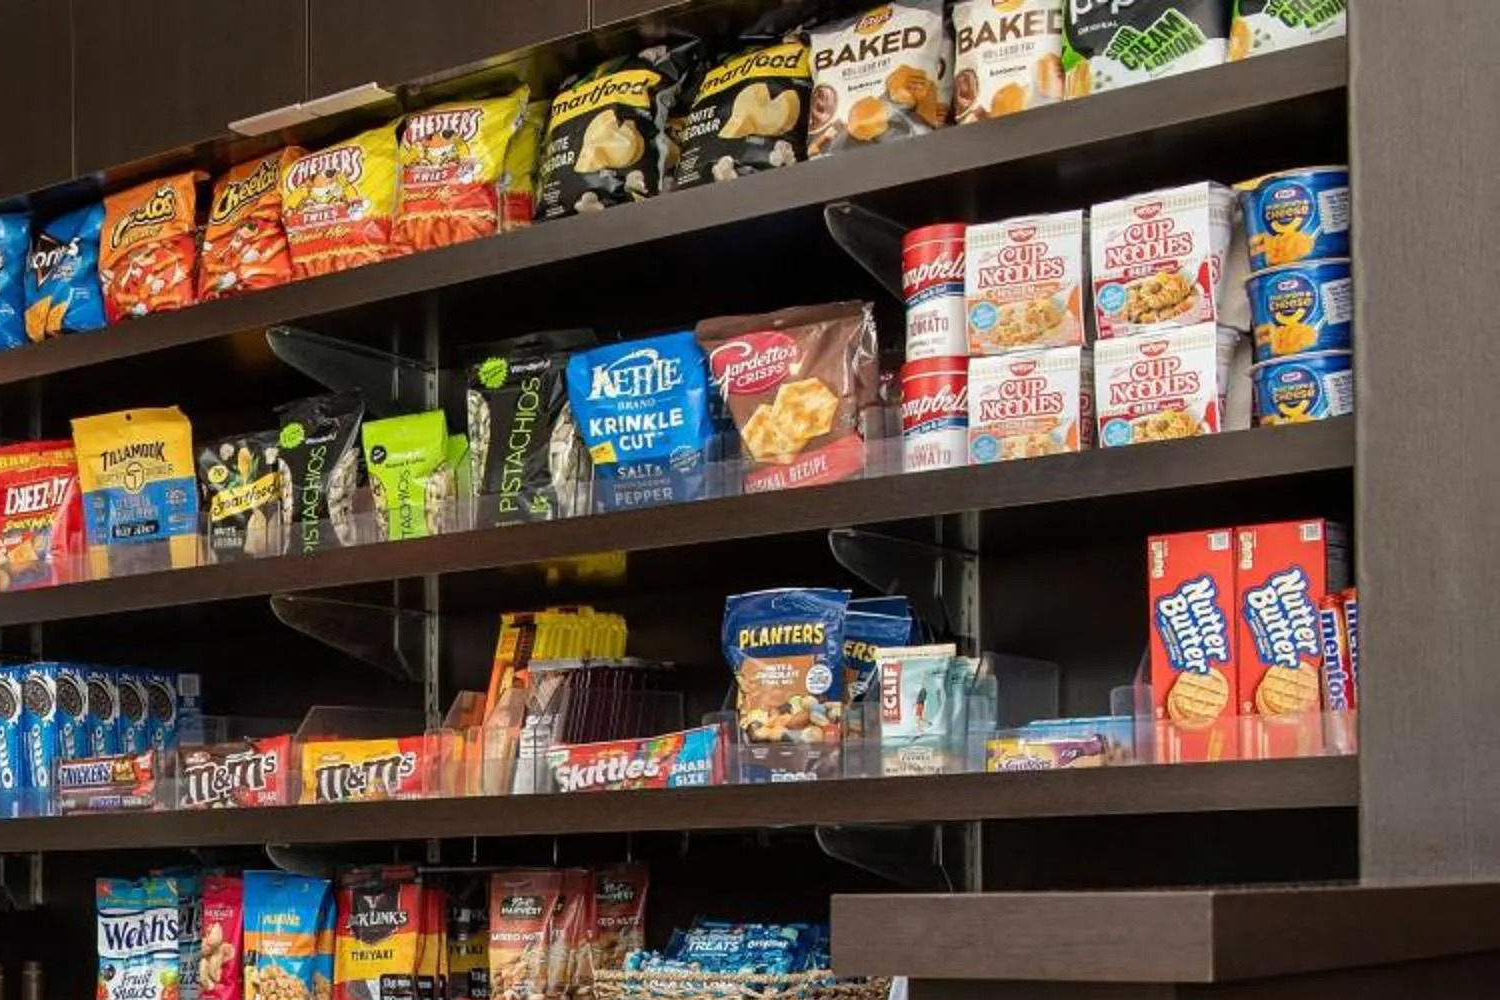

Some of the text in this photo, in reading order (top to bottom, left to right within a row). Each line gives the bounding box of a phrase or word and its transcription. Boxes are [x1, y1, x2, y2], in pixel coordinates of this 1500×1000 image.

[815, 25, 927, 70] BAKED
[1119, 10, 1188, 71] CREAM
[703, 47, 805, 90] martfood
[552, 77, 650, 117] martfood
[1124, 218, 1174, 244] CUP
[998, 243, 1049, 265] CUP
[1105, 233, 1193, 269] NOODLES
[978, 257, 1065, 288] NOODLES
[586, 349, 684, 400] KETTLE
[735, 363, 785, 387] CRISPS
[1131, 357, 1181, 381] CUP
[1000, 379, 1046, 399] CUP
[1110, 372, 1200, 406] NOODLES
[589, 408, 685, 437] KRINKLE
[980, 393, 1064, 421] NOODLES
[100, 442, 167, 472] TILLAMOOK
[499, 375, 541, 513] PISTACHIOS
[618, 433, 655, 452] CUT
[616, 463, 652, 480] SALT
[789, 454, 830, 481] RECIPE
[614, 486, 674, 506] PEPPER
[1181, 576, 1228, 661] Nutter
[1247, 585, 1297, 669] Butter
[1271, 568, 1319, 655] Nutter
[739, 623, 826, 650] PLANTERS
[1158, 595, 1207, 673] Butter
[554, 755, 661, 793] Skittles
[101, 914, 178, 951] Welch's
